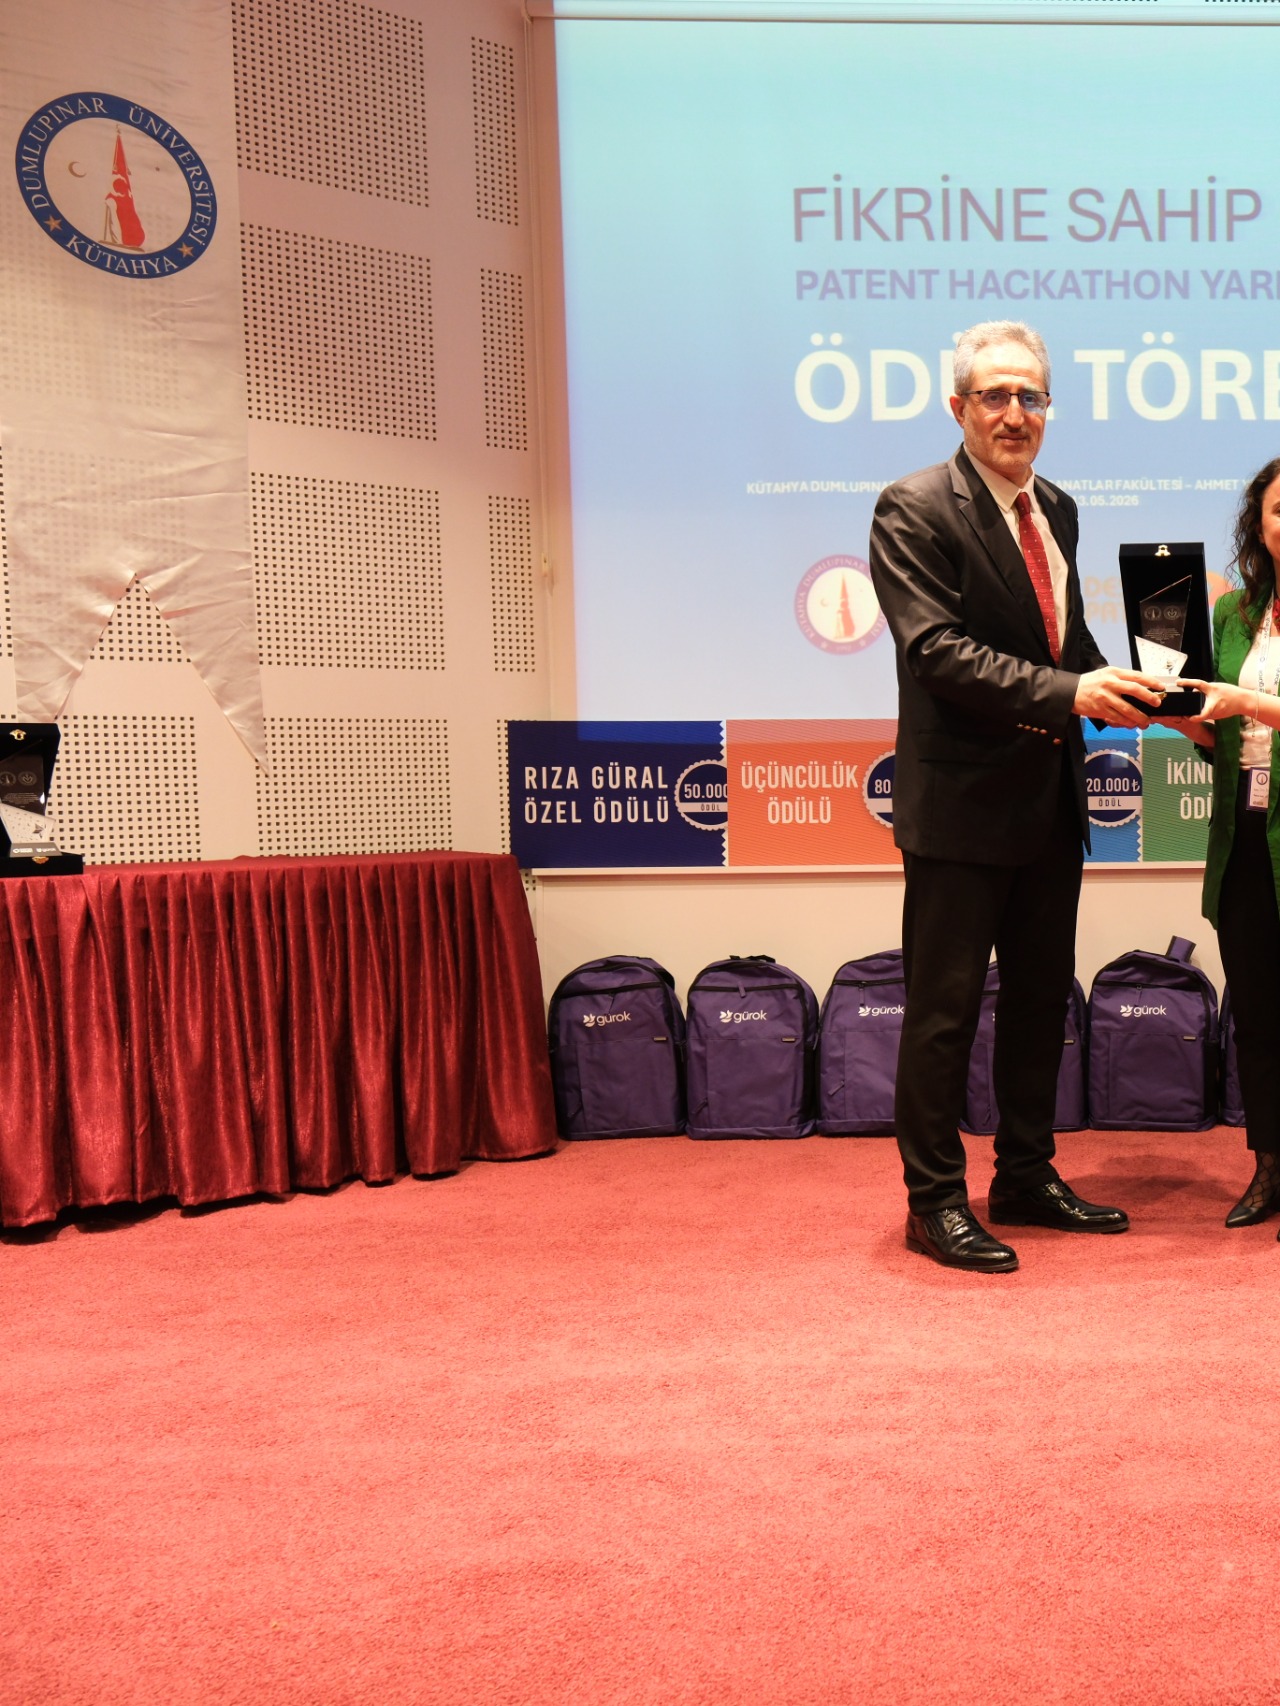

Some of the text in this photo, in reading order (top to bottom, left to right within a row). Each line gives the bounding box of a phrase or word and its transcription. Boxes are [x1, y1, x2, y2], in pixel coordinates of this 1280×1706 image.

[21, 97, 212, 247] DUMLUPINAR ÜNİVERSİTESİ
[793, 173, 1049, 242] FİKRİNE
[1067, 175, 1263, 243] SAHİP
[66, 234, 179, 275] KÜTAHYA
[795, 269, 940, 300] PATENT
[949, 269, 1190, 300] HACKATHON
[746, 480, 809, 494] KÜTAHYA
[1115, 477, 1184, 491] FAKÜLTESİ
[1195, 479, 1239, 490] AHMET
[524, 761, 669, 790] RIZA GÜRAL
[741, 761, 859, 793] ÜÇÜNCÜLÜK
[524, 796, 669, 824] ÖZEL ÖDÜLÜ
[700, 803, 721, 812] ÖDÜL
[767, 796, 831, 824] ÖDÜLÜ
[1098, 798, 1122, 807] ÖDÜL
[597, 1012, 631, 1027] gürok
[733, 1009, 767, 1023] gürok
[871, 1005, 904, 1018] gürok
[1133, 1004, 1166, 1018] gürok
